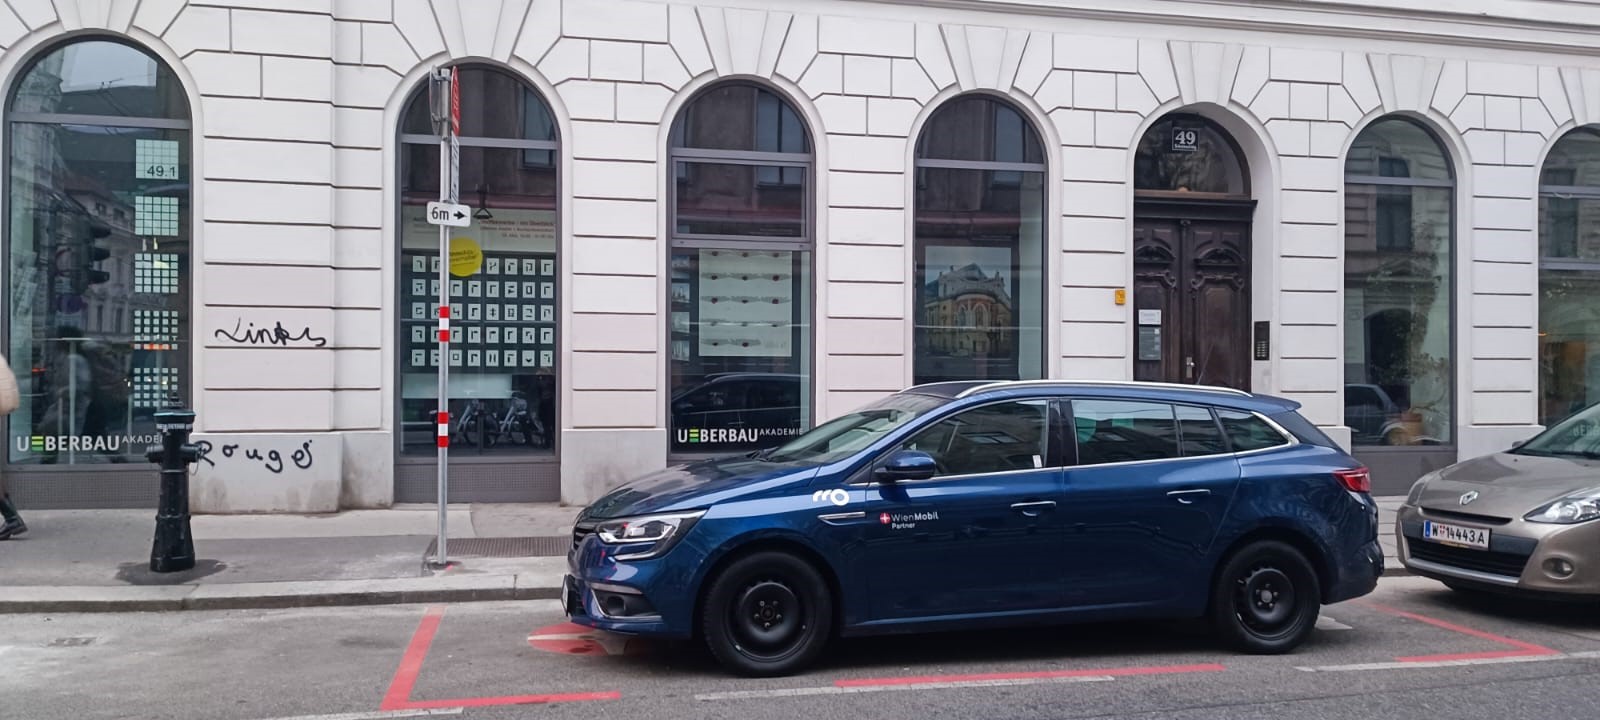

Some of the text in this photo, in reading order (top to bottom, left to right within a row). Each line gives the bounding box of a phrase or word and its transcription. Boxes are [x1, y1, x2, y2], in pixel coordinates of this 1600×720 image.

[1175, 131, 1196, 144] 49
[146, 165, 176, 177] 49.1
[431, 206, 449, 221] 6m
[677, 427, 803, 443] UEBERBAU AKADEMIE
[16, 435, 120, 452] UEBERBAU
[890, 511, 939, 522] WienMobil
[891, 522, 916, 530] Partner
[1432, 524, 1485, 544] W 14443 A
